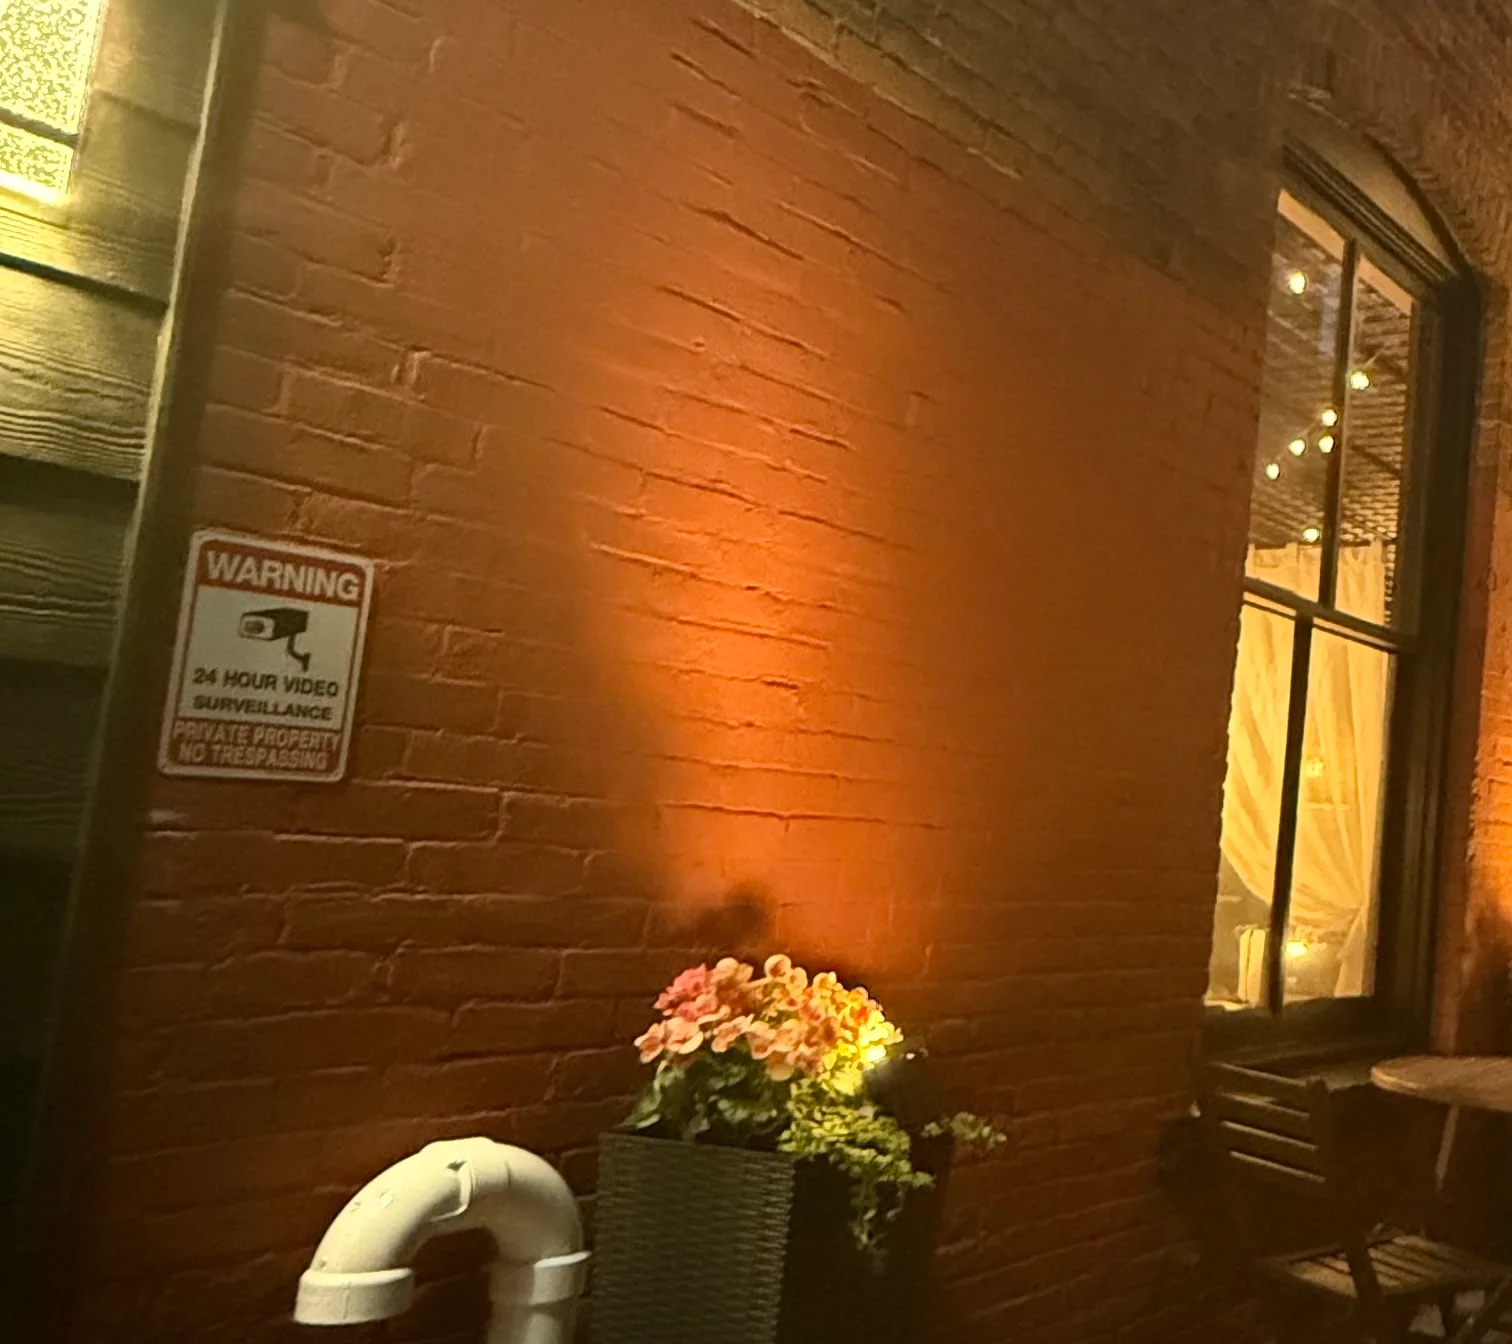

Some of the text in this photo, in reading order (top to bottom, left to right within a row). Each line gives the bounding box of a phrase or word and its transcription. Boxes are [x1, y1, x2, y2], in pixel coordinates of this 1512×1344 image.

[206, 550, 360, 602] WARNING
[193, 667, 339, 698] 24 HOUR VIDEO
[192, 694, 333, 721] SURVEILLANCE
[173, 719, 342, 752] PRIVATE PROPERTY
[177, 742, 330, 771] NO TRESPASSING
